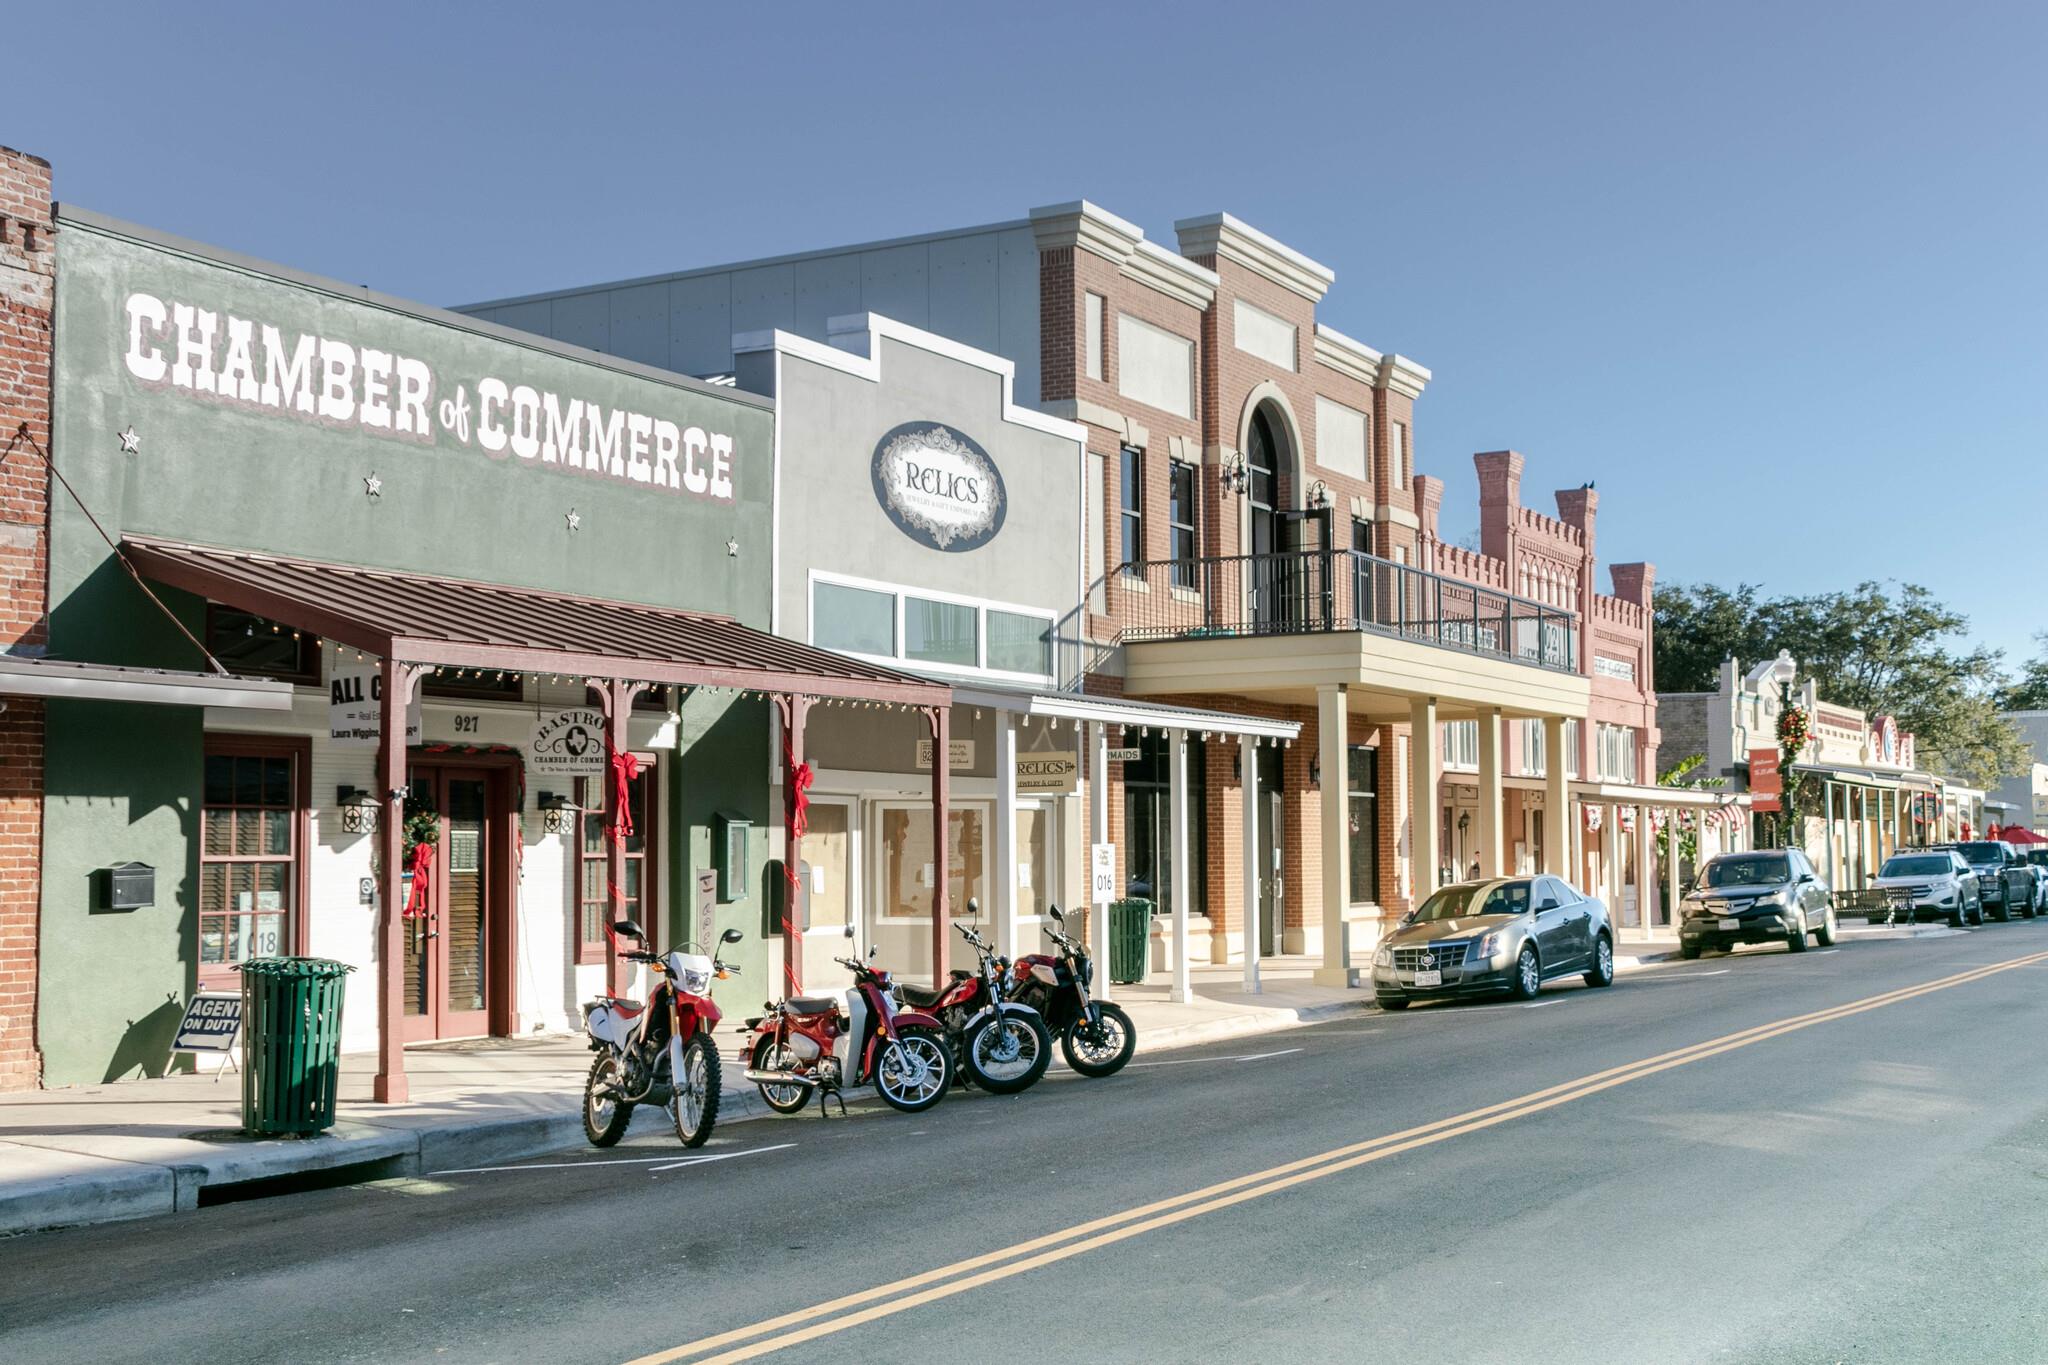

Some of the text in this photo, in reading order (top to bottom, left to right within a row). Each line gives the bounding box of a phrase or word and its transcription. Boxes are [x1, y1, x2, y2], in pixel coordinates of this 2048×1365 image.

[125, 293, 733, 499] CHAMBER of COMMERCE
[906, 461, 979, 504] RELICS
[331, 677, 364, 705] ALL
[454, 714, 479, 733] 927
[538, 711, 605, 739] BASTRO
[331, 729, 351, 738] Laura
[1017, 762, 1064, 774] RELICS
[1097, 874, 1112, 890] 016
[189, 1000, 242, 1018] AGENT
[184, 1018, 239, 1031] ON DUTY
